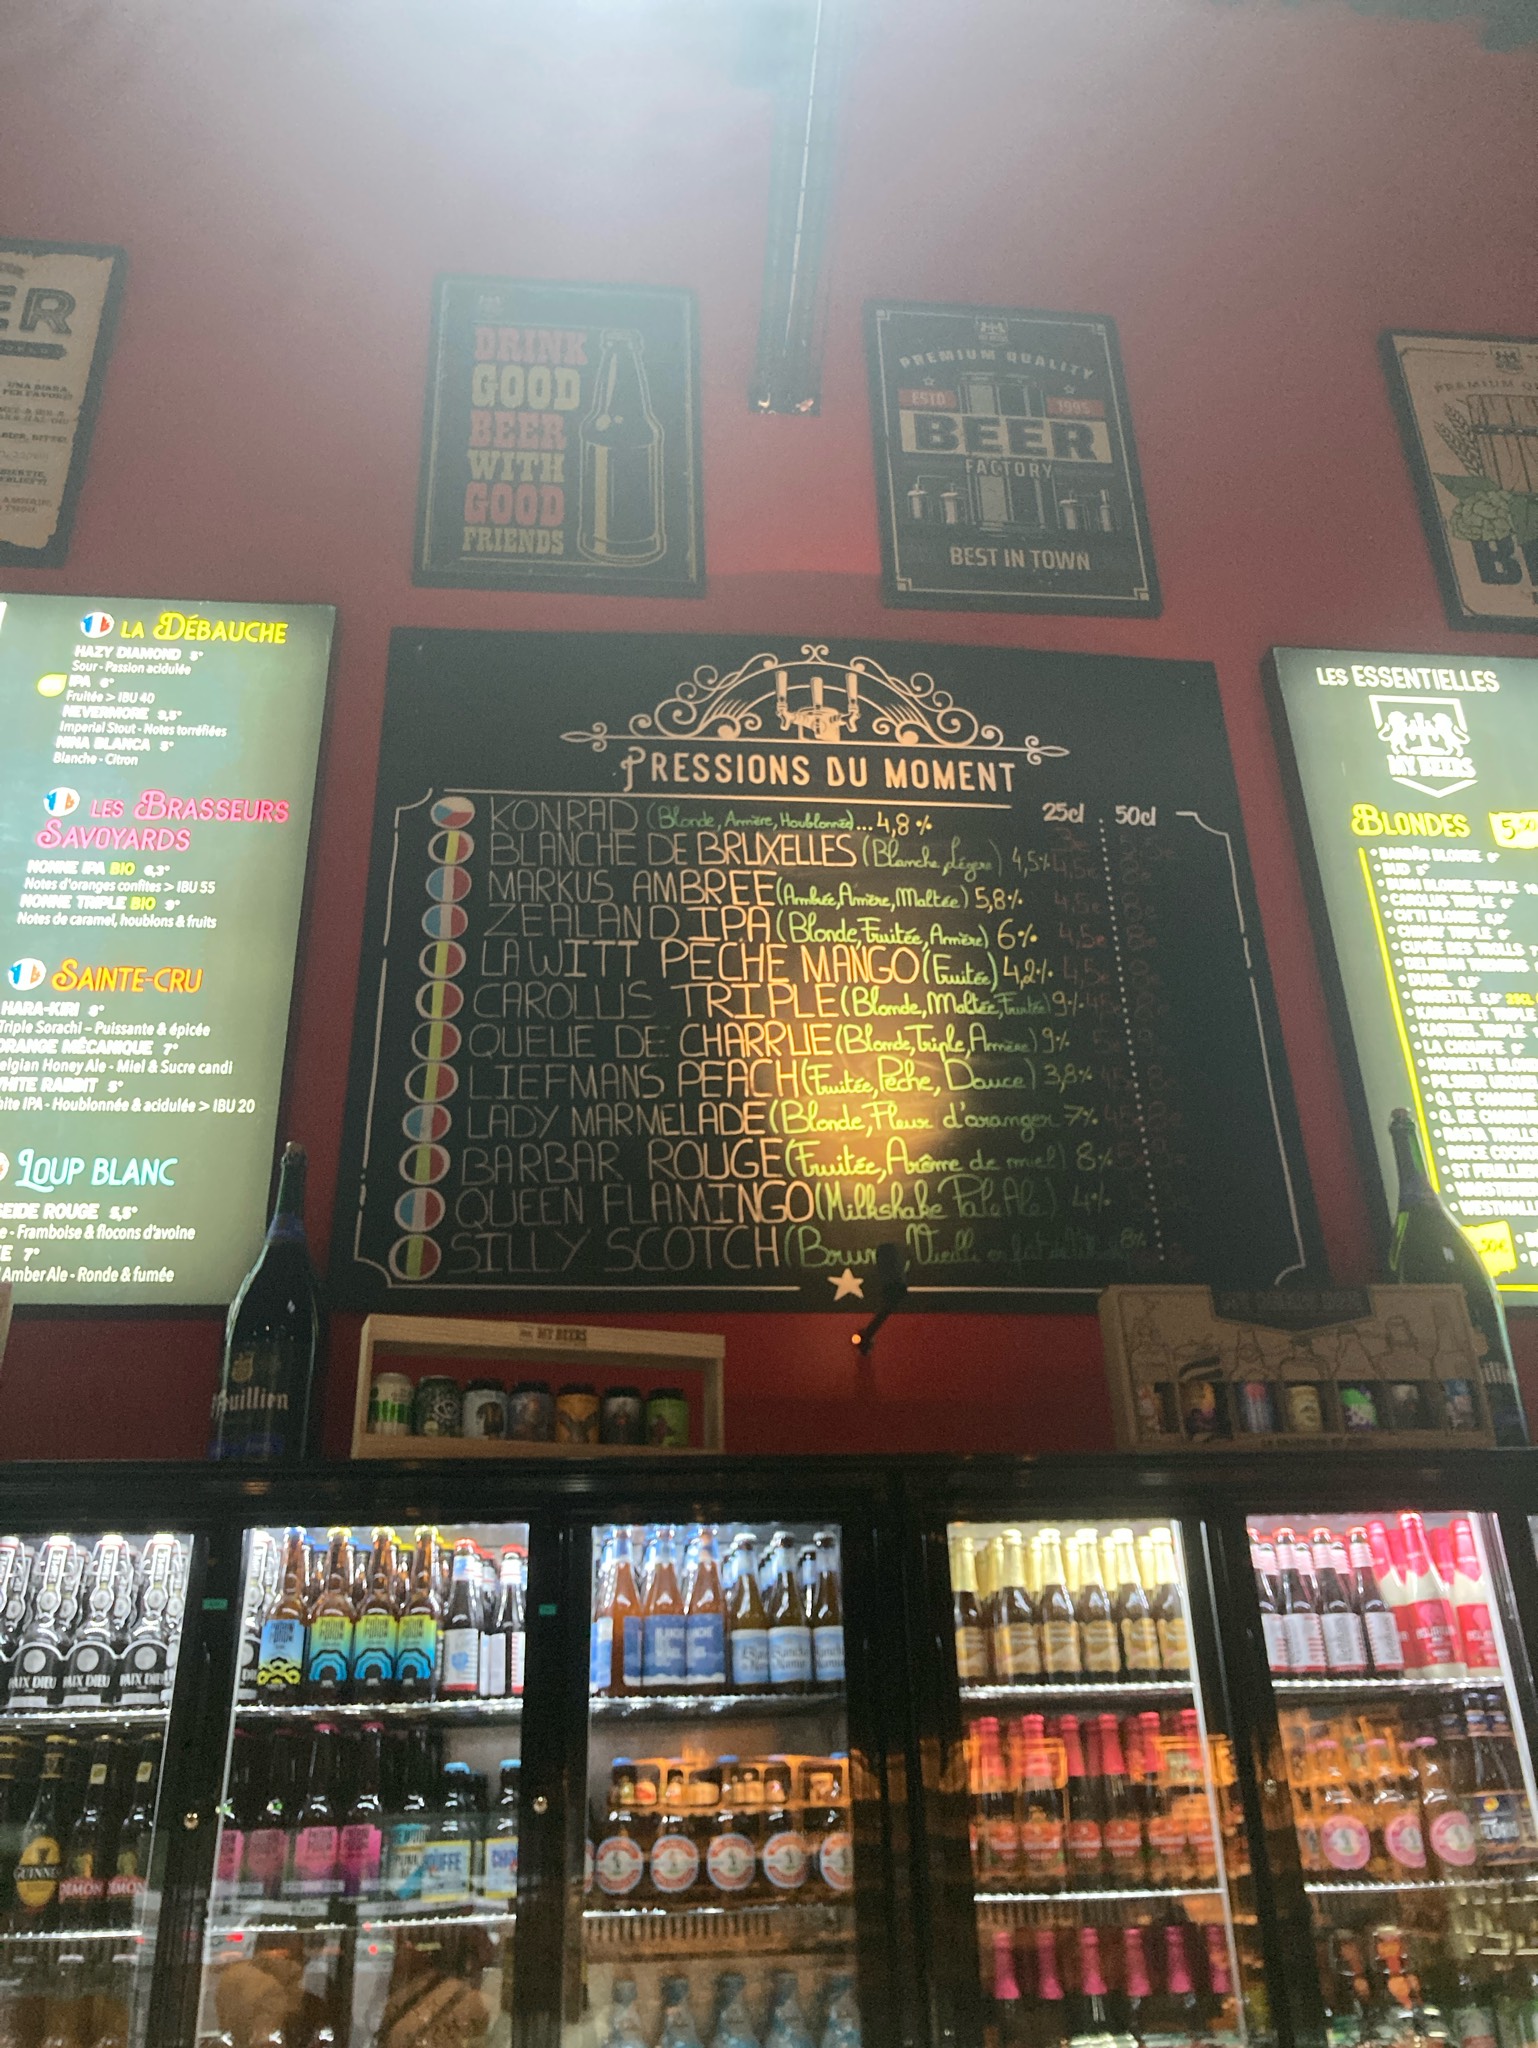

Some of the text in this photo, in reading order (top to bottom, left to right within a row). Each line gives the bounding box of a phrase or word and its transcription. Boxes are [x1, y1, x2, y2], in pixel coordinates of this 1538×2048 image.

[473, 326, 588, 366] DRINK
[899, 349, 1094, 381] PREMIUM QUALITY
[472, 363, 581, 411] GOOD
[911, 391, 945, 407] ESTD
[468, 409, 567, 451] BEER
[913, 413, 1098, 462] BEER
[466, 450, 565, 484] WITH
[965, 458, 1053, 479] FACTORY
[464, 480, 565, 527] GOOD
[462, 526, 564, 555] FRIENDS
[950, 546, 1091, 571] BEST IN TOWN
[120, 610, 289, 645] LA DÉBAUCHE
[71, 660, 98, 674] Sour
[104, 661, 145, 676] Passion
[74, 645, 182, 661] HAZY DIAMOND
[68, 674, 91, 689] IPA
[1316, 664, 1501, 693] LES ESSENTIELLES
[62, 705, 149, 720] NEVERMORE
[65, 690, 104, 704] Fruitée
[117, 691, 139, 704] IBU
[59, 721, 105, 735] Imperial
[107, 722, 136, 736] Stout
[144, 723, 175, 737] Notes
[52, 752, 139, 767] Blanche Citron
[620, 746, 1016, 793] PRESSIONS DU MOMENT
[1387, 754, 1418, 777] MY
[89, 788, 291, 825] LES BRASSEURS
[489, 796, 640, 832] KONRAD
[1042, 801, 1157, 827] 25cl 50cl
[1351, 801, 1472, 838] BLONDES
[35, 818, 192, 852] SAVOYARDS
[489, 830, 859, 868] BLANCHE DE BRUXELLES
[24, 876, 217, 895] Notes d'oranges confites IBU 55
[109, 861, 136, 877] BIO
[129, 896, 157, 912] BIO
[488, 869, 614, 904] MARKUS
[632, 868, 778, 907] AMBREE
[17, 910, 217, 929] Notes de caramel, houblons fruits
[483, 903, 681, 942] ZEALAND
[686, 904, 772, 944] IPA
[51, 957, 205, 995] SAINTE-CRU
[659, 937, 790, 983] PECHE
[799, 941, 920, 986] MANGO
[473, 980, 842, 1020] CAROLUS TRIPLE
[0, 1020, 211, 1038] Triple Sorachi Puissante épicée
[469, 1022, 597, 1060] QUEUE
[614, 1024, 671, 1060] DE
[679, 1020, 837, 1058] CHARRUE
[41, 1059, 233, 1076] Honey Ale Miel Sucre candi
[468, 1062, 666, 1101] LIEFMANS
[677, 1057, 803, 1099] PEACH
[22, 1097, 256, 1115] IPA Houblonnée acidulée IBU 20
[467, 1104, 560, 1140] LADY
[571, 1100, 768, 1138] MARMELADE
[14, 1148, 179, 1194] LOUP BLANC
[462, 1139, 625, 1187] BARBAR
[648, 1137, 785, 1182] ROUGE
[968, 1148, 1001, 1172] de
[42, 1202, 101, 1220] ROUGE
[455, 1186, 585, 1231] QUEEN
[601, 1180, 816, 1225] FLAMINGO
[17, 1224, 196, 1242] Framboise flocons d'avoine
[450, 1228, 592, 1275] SILLY
[603, 1224, 781, 1273] SCOTCH
[1, 1267, 175, 1285] Amber Ale Ronde fumée
